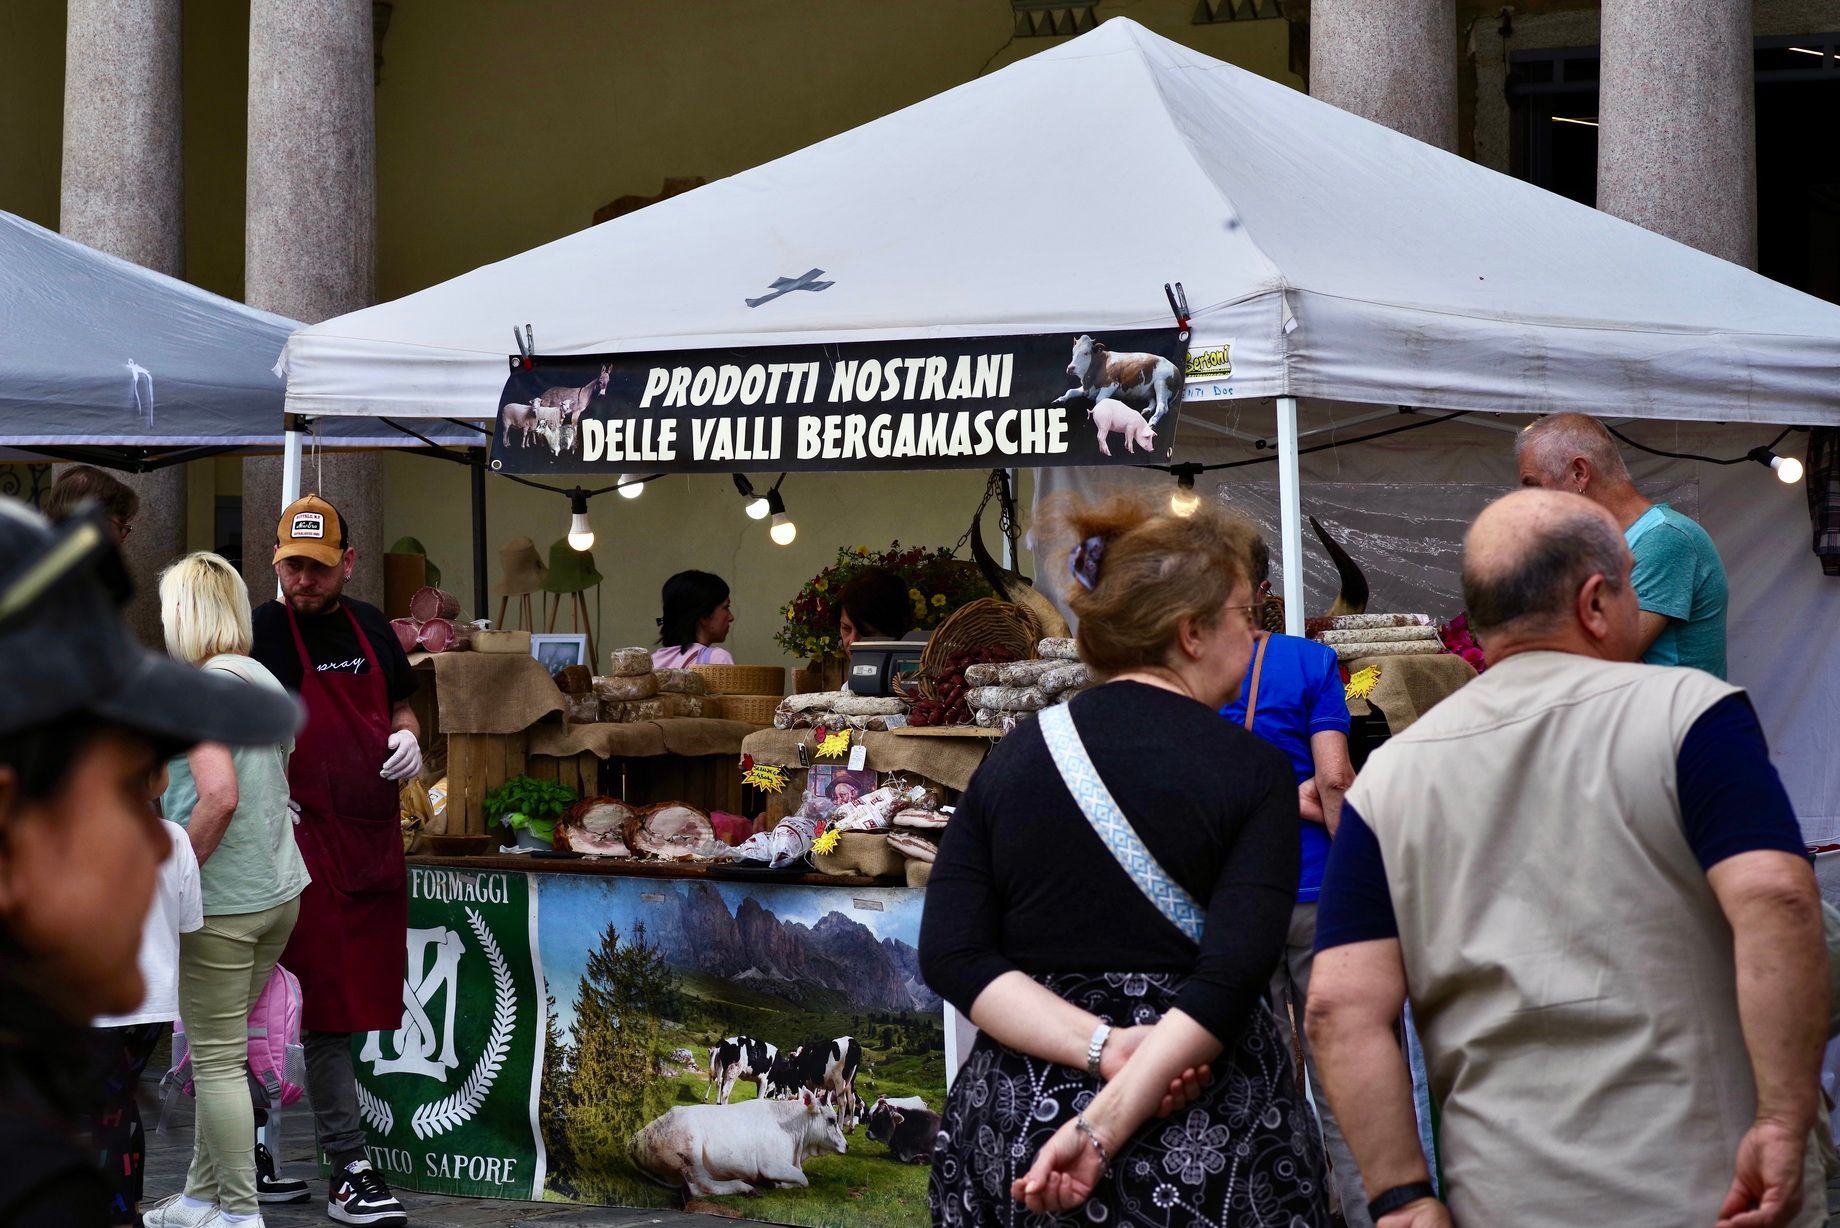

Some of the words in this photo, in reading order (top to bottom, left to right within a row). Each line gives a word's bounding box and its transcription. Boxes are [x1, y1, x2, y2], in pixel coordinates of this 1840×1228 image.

[640, 361, 820, 408] PRODOTTI
[828, 353, 1014, 403] NOSTRANI
[582, 418, 677, 463] DELLE
[691, 416, 783, 461] VALLI
[796, 407, 1069, 461] BERGAMASCHE
[412, 869, 509, 904] FORMAGGI
[426, 1152, 517, 1185] SAPORE
